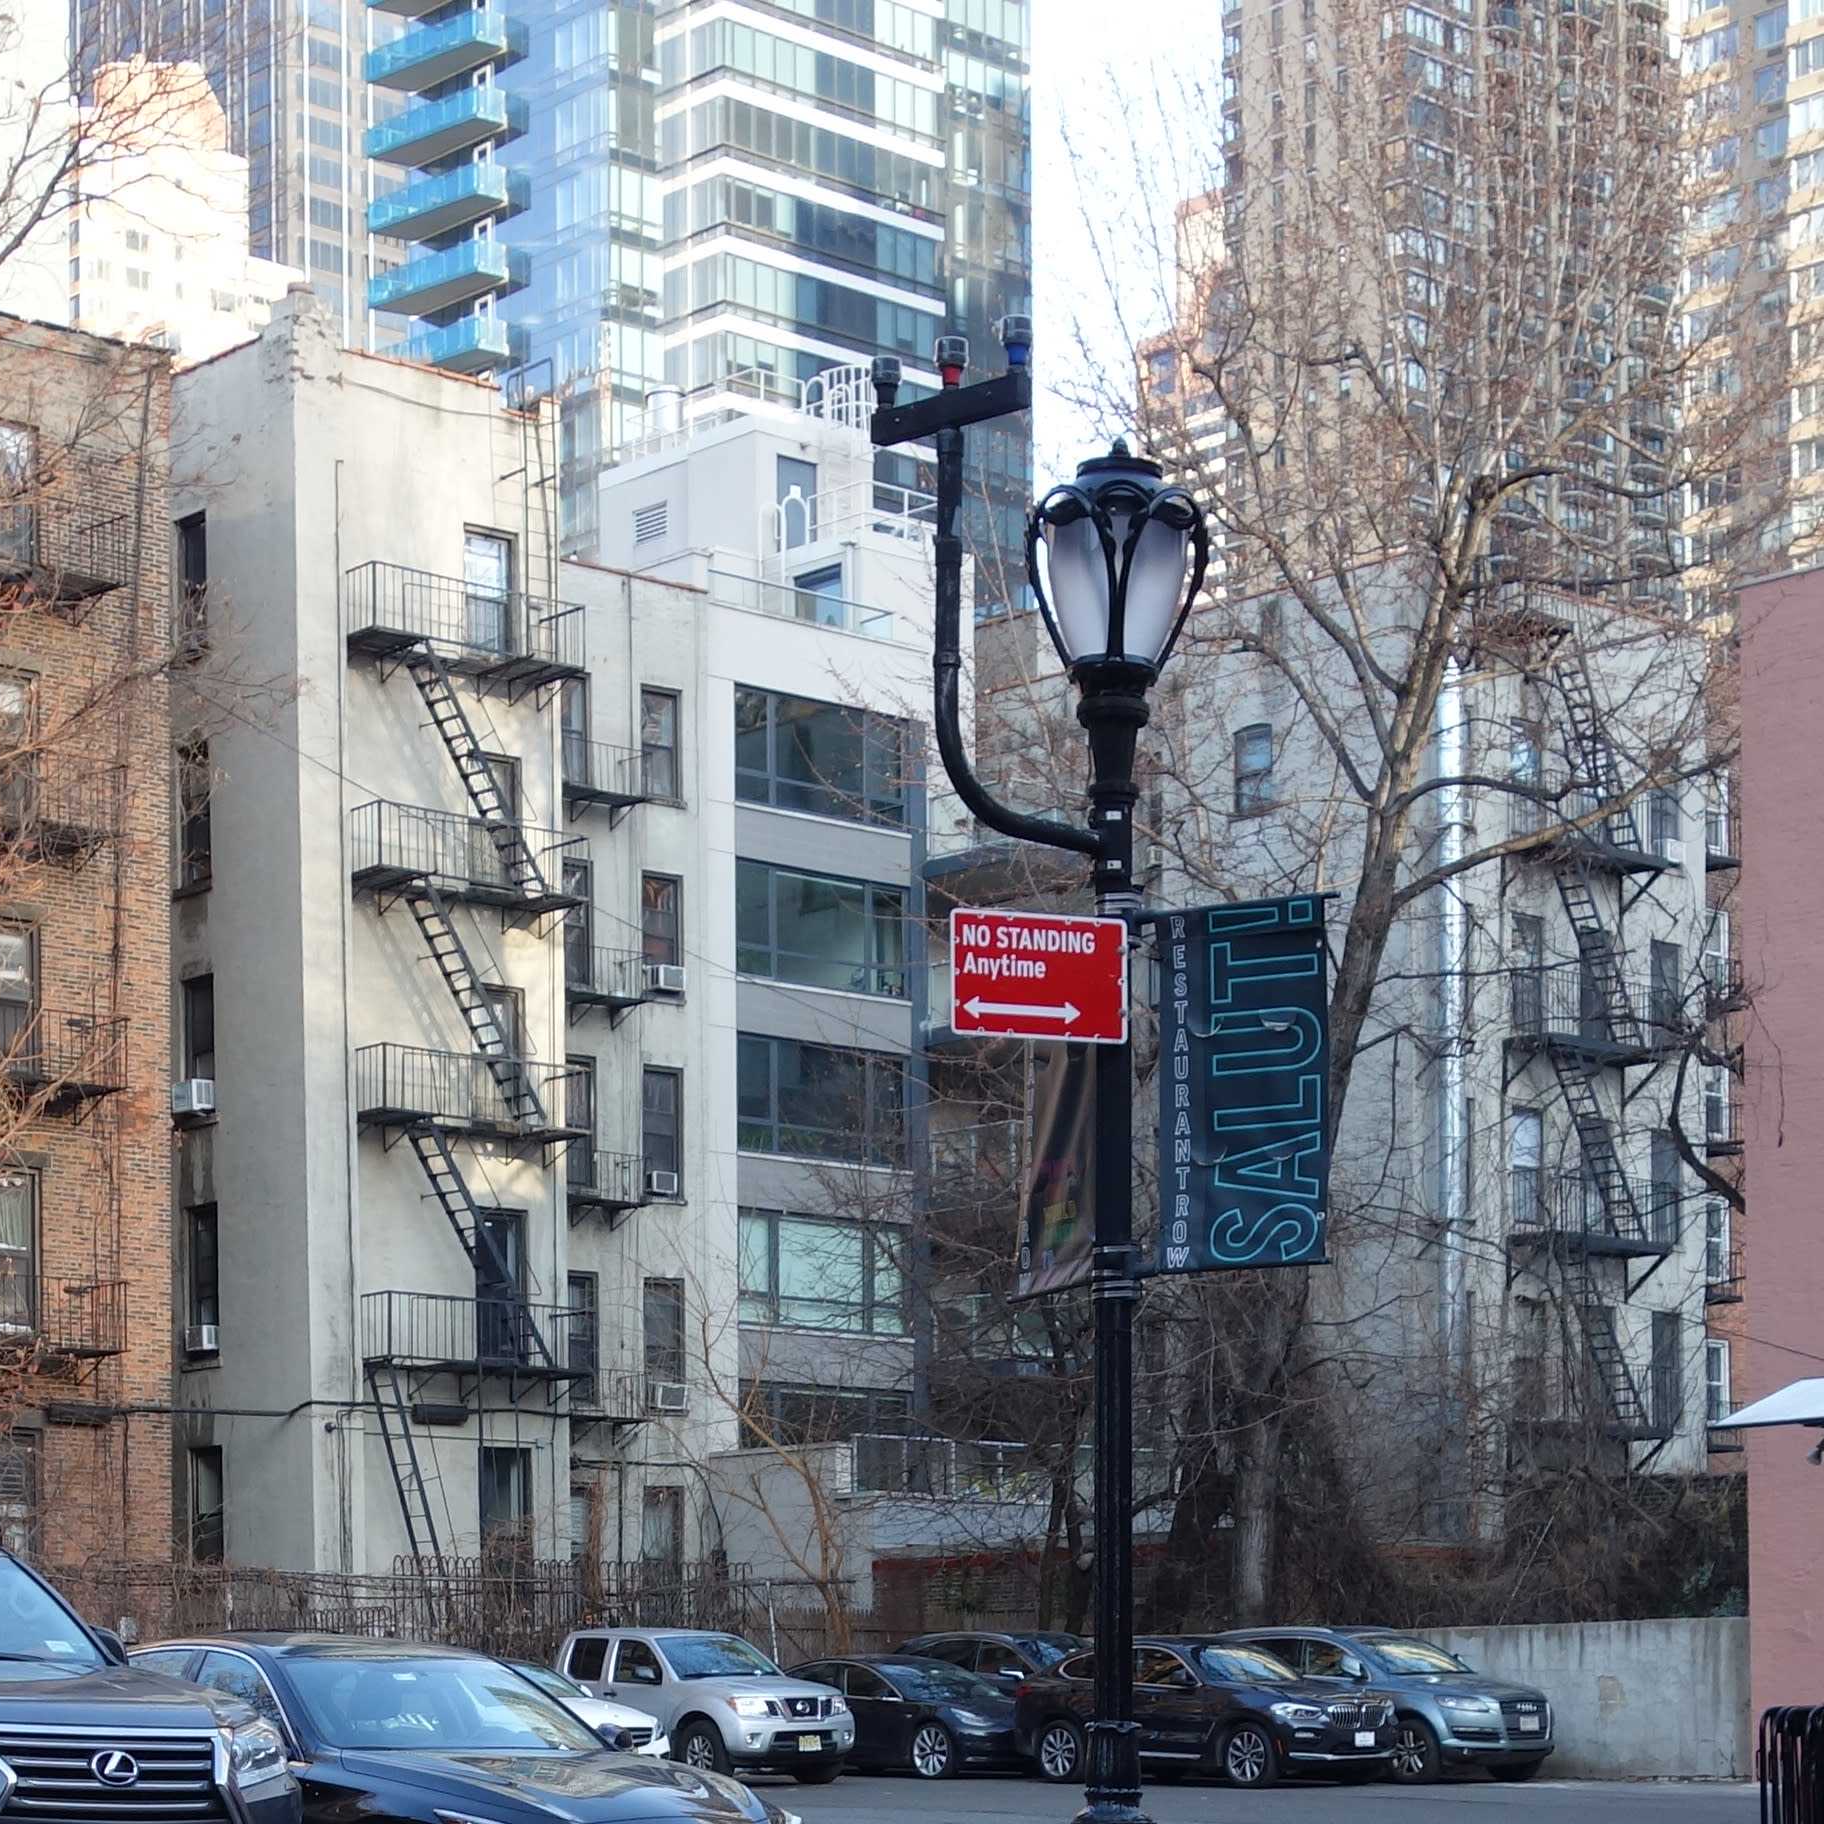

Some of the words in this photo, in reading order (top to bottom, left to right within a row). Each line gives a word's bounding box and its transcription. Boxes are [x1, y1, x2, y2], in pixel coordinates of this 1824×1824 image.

[962, 924, 991, 950] NO
[995, 925, 1096, 955] STANDING
[962, 951, 1047, 980] Anytime
[1209, 899, 1323, 1264] SALUT!
